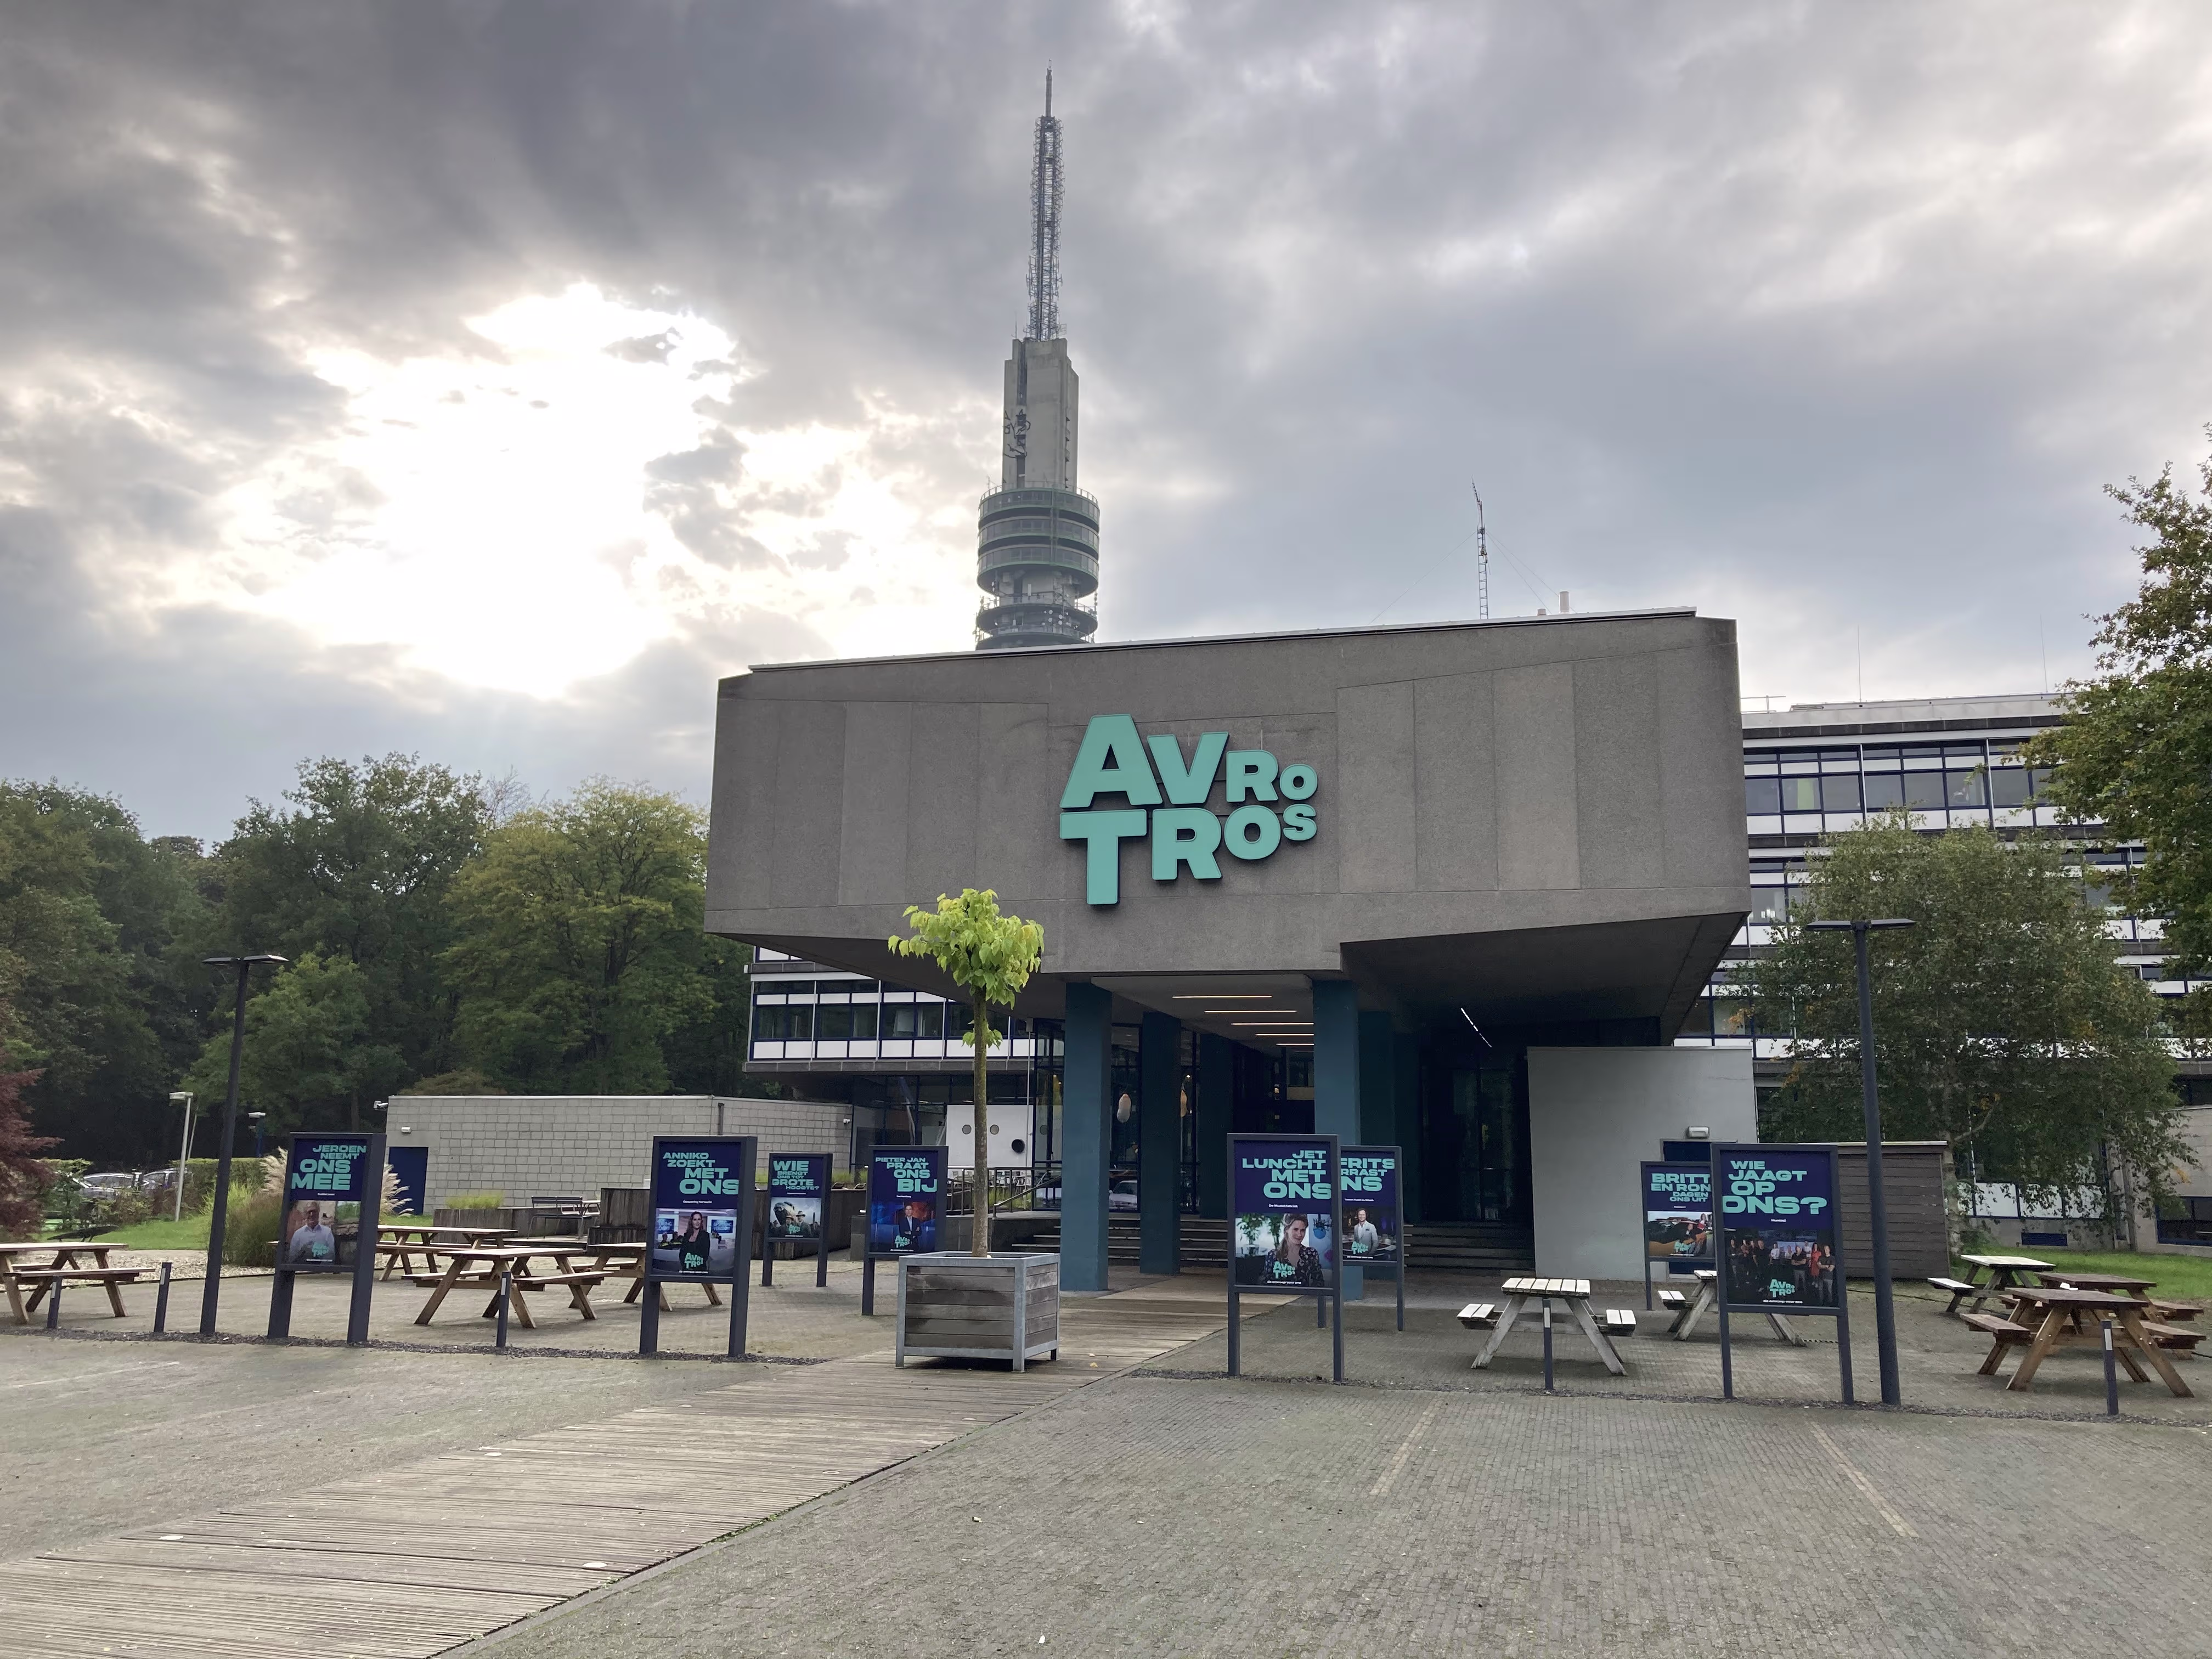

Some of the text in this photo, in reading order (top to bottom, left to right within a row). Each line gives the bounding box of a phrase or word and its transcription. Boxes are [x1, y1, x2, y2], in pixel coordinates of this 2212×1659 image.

[312, 1144, 367, 1153] JEROEN
[1292, 1150, 1327, 1159] JET
[300, 1159, 351, 1173] ONS
[667, 1159, 716, 1167] ZOEKT
[773, 1160, 809, 1171] WIE
[1242, 1158, 1327, 1170] LUNCHT
[1730, 1160, 1765, 1170] WIE
[685, 1167, 729, 1179] MET
[893, 1169, 930, 1178] ONS
[1271, 1169, 1327, 1182] MET
[1340, 1168, 1388, 1177] RRAST
[1652, 1173, 1711, 1184] BRITT
[1728, 1170, 1808, 1181] JAAGT
[291, 1172, 352, 1190] MEE
[679, 1178, 740, 1195] ONS
[897, 1178, 938, 1193] BIJ
[1341, 1176, 1383, 1192] NS
[1263, 1182, 1332, 1200] ONS
[1651, 1183, 1711, 1192] EN RON
[1731, 1181, 1775, 1196] OP
[1722, 1195, 1827, 1215] ONS?
